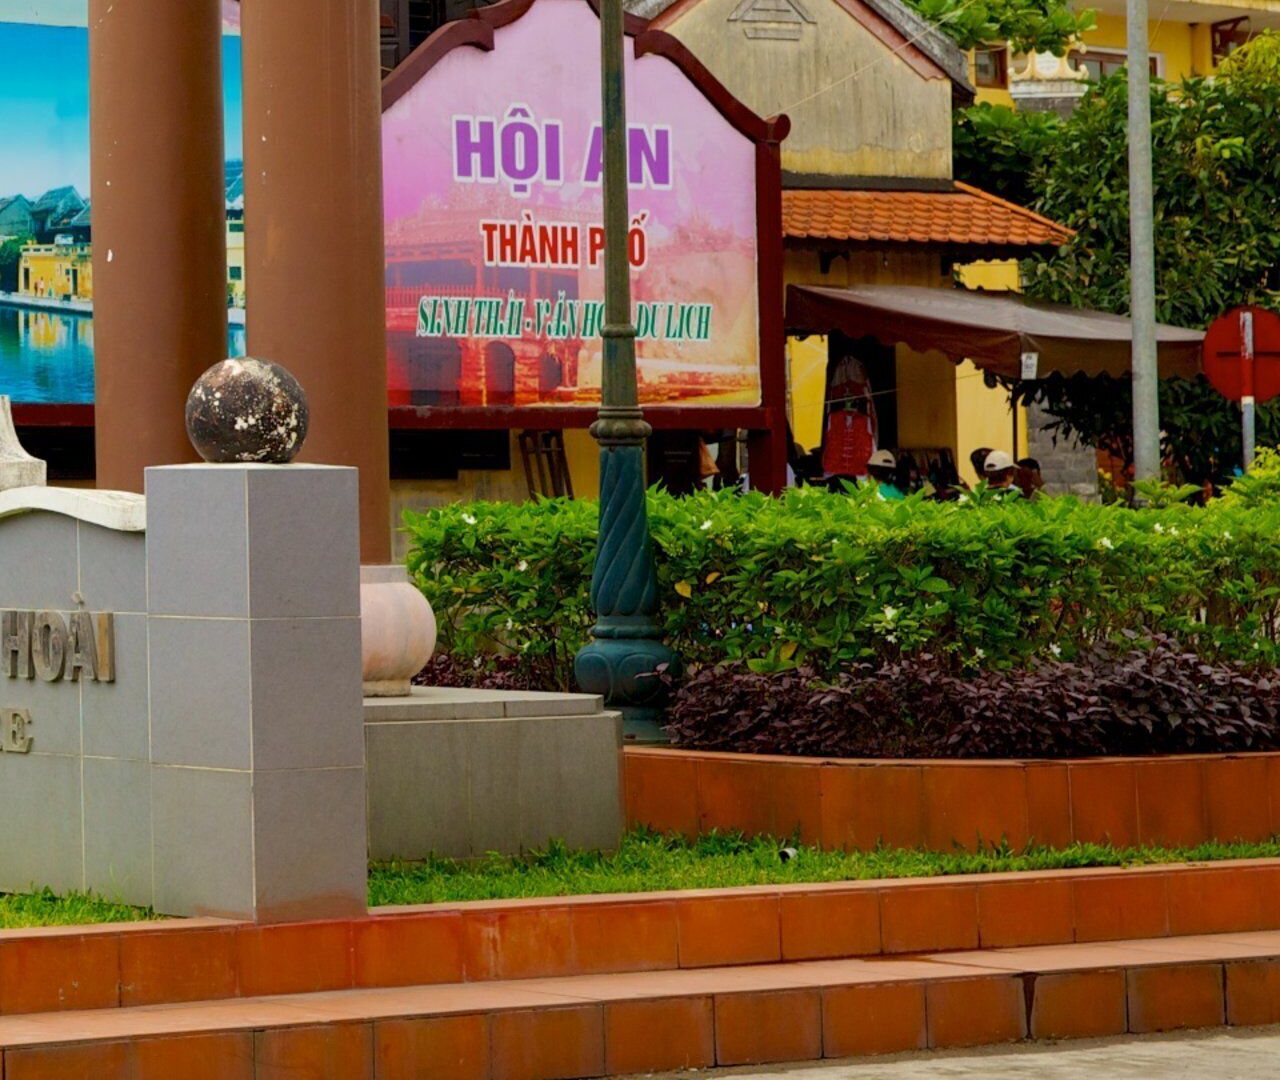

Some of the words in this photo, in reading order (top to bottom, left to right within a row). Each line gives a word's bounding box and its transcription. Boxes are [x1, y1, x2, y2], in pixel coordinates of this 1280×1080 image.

[455, 107, 561, 193] HỘI
[482, 213, 579, 265] THÀNH
[589, 213, 646, 267] PỐ
[417, 298, 470, 336] SINH
[473, 290, 524, 336] THÁI
[636, 303, 662, 338] DU
[664, 304, 713, 347] LỊCH
